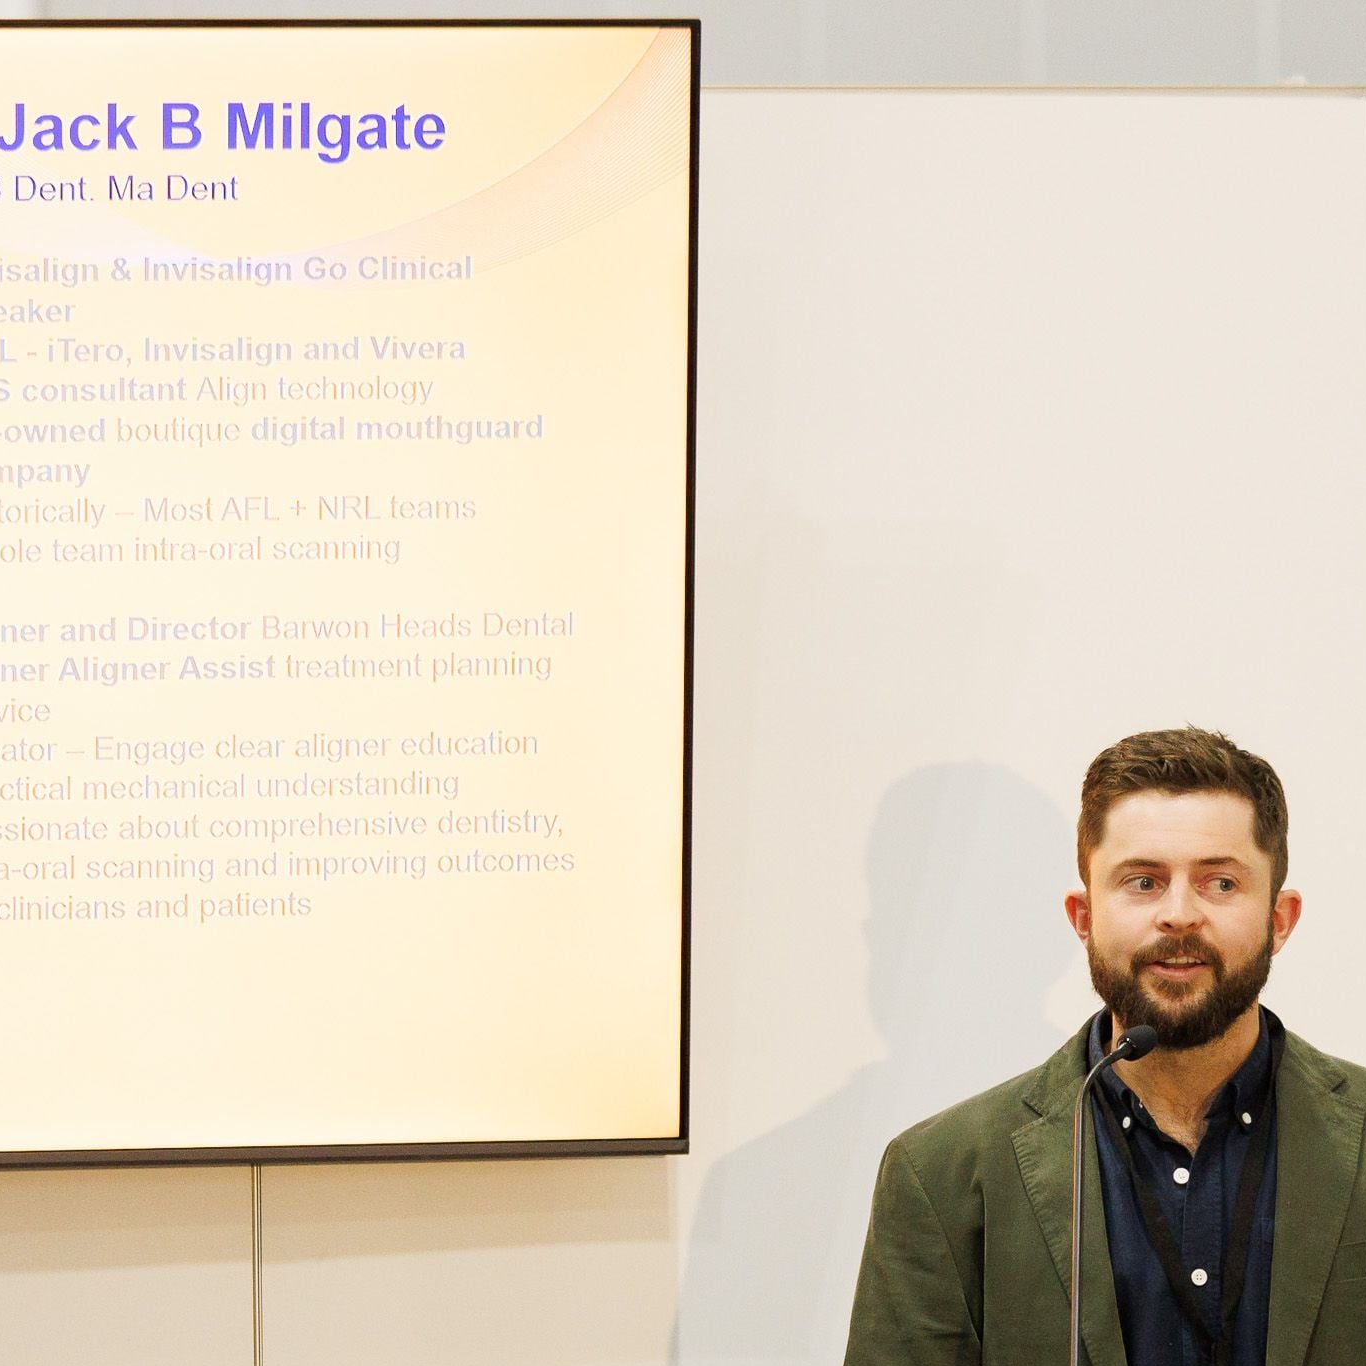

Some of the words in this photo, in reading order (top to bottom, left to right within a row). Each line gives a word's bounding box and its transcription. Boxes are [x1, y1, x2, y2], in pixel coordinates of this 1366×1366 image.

[162, 102, 202, 150] B
[227, 102, 447, 164] Milgate
[15, 175, 94, 201] Dent.
[108, 175, 153, 200] Ma
[167, 175, 238, 200] Dent
[110, 256, 132, 281] &
[141, 254, 293, 287] Invisalign
[303, 255, 347, 282] Go
[356, 255, 474, 281] Clinical
[47, 337, 132, 367] iTero,
[143, 336, 294, 366] Invisalign
[302, 336, 362, 362] and
[369, 336, 467, 360] Vivera
[21, 377, 187, 402] consultant
[197, 376, 267, 407] Align
[276, 375, 434, 405] technology
[117, 417, 240, 448] boutique
[250, 416, 346, 447] digital
[355, 414, 545, 445] mouthguard
[142, 496, 212, 522] Most
[221, 496, 280, 522] AFL
[318, 495, 381, 521] NRL
[390, 495, 476, 520] teams
[53, 539, 123, 562] team
[135, 536, 261, 561] intra-oral
[272, 535, 400, 564] scanning
[59, 616, 116, 642] and
[126, 616, 251, 641] Director
[262, 615, 370, 640] Barwon
[379, 612, 471, 640] Heads
[483, 611, 576, 637] Dental
[58, 656, 171, 687] Aligner
[178, 655, 275, 680] Assist
[286, 653, 421, 680] treatment
[432, 651, 551, 683] planning
[94, 736, 206, 766] Engage
[215, 734, 285, 759] clear
[294, 732, 391, 762] aligner
[400, 730, 539, 755] education
[83, 773, 247, 800] mechanical
[255, 769, 459, 800] understanding
[119, 814, 199, 840] about
[209, 811, 428, 843] comprehensive
[438, 809, 563, 838] dentistry,
[86, 853, 216, 883] scanning
[225, 852, 279, 877] and
[287, 850, 427, 881] improving
[437, 848, 575, 873] outcomes
[136, 893, 188, 918] and
[200, 892, 312, 924] patients
